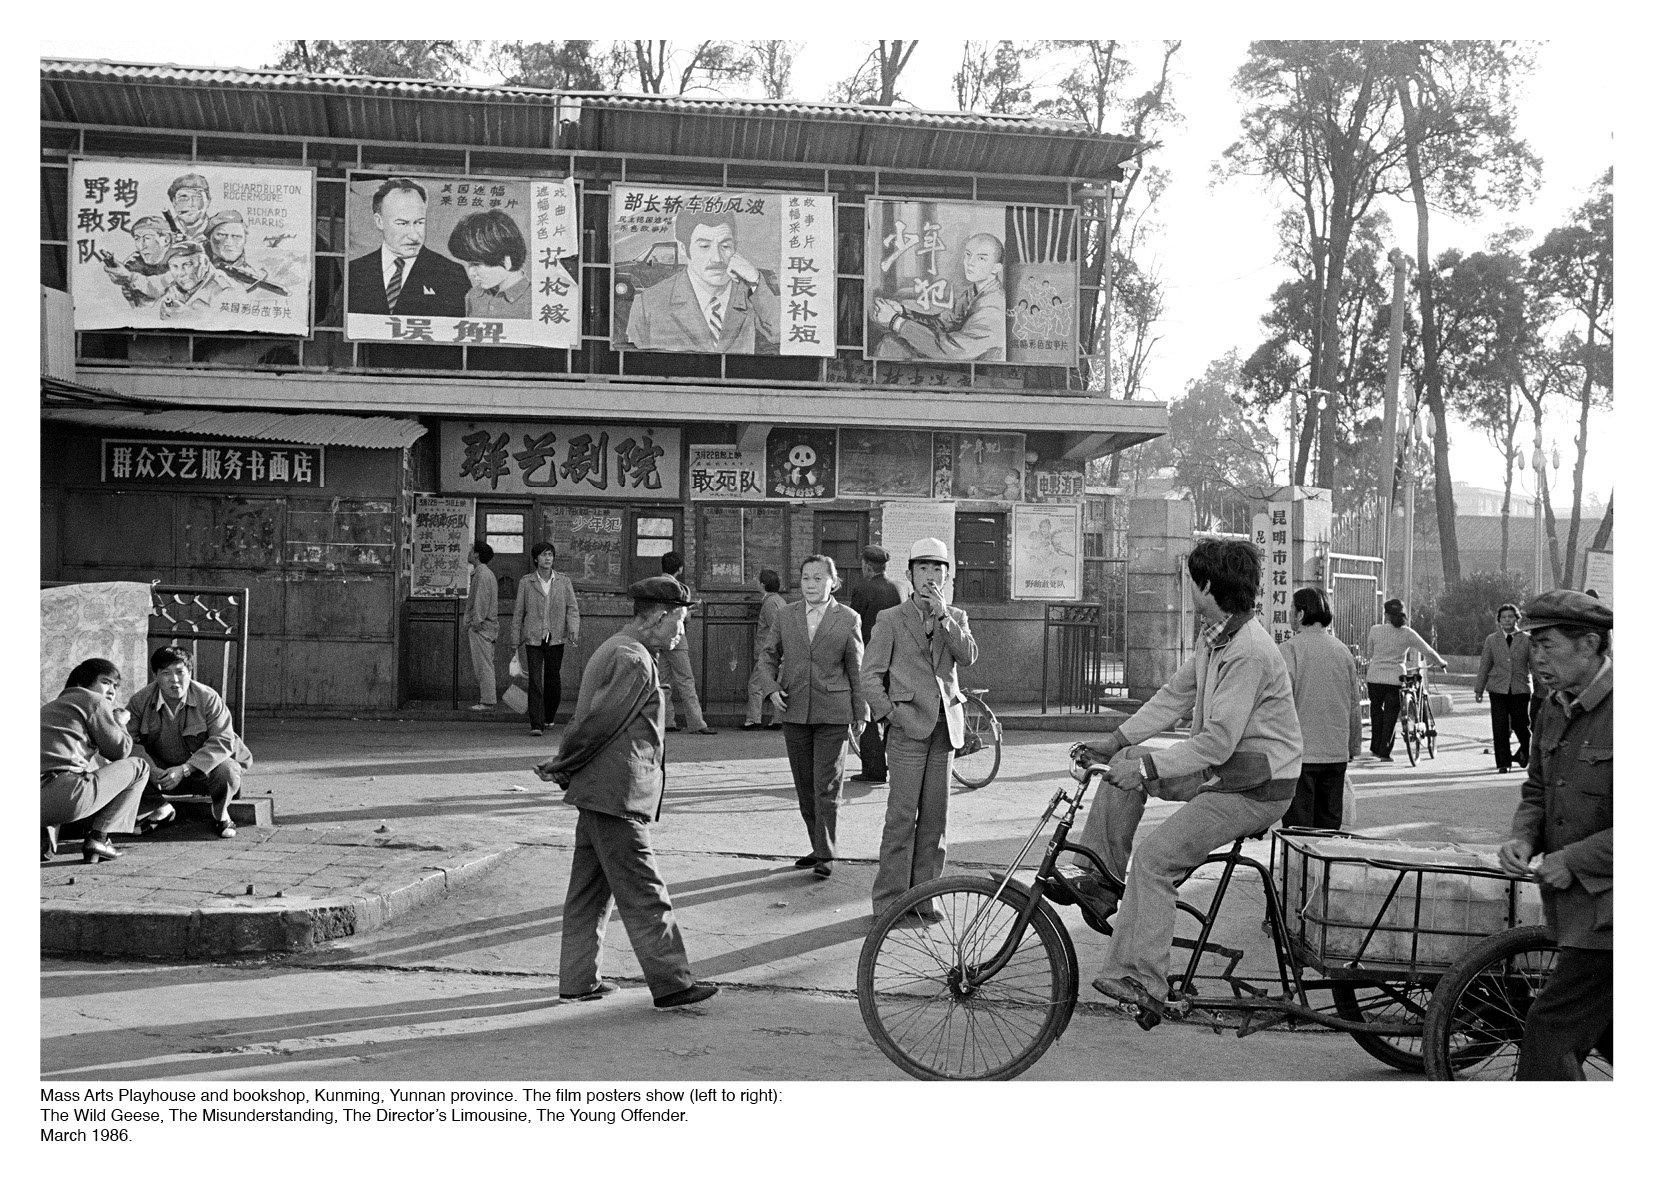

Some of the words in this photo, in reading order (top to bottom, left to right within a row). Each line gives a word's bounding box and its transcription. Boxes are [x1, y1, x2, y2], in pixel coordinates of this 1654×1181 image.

[84, 177, 138, 208] 野鹅
[624, 192, 765, 216] 部长轿车的风波
[78, 208, 132, 234] 敢死
[247, 206, 287, 218] RICHARD
[247, 217, 284, 228] HARRIS
[803, 197, 815, 249] 故事片
[77, 239, 102, 264] 队
[385, 316, 507, 343] 误解
[111, 446, 313, 483] 群众文艺服务书画店
[459, 430, 665, 490] 群艺剧院
[570, 515, 622, 533] 少年犯
